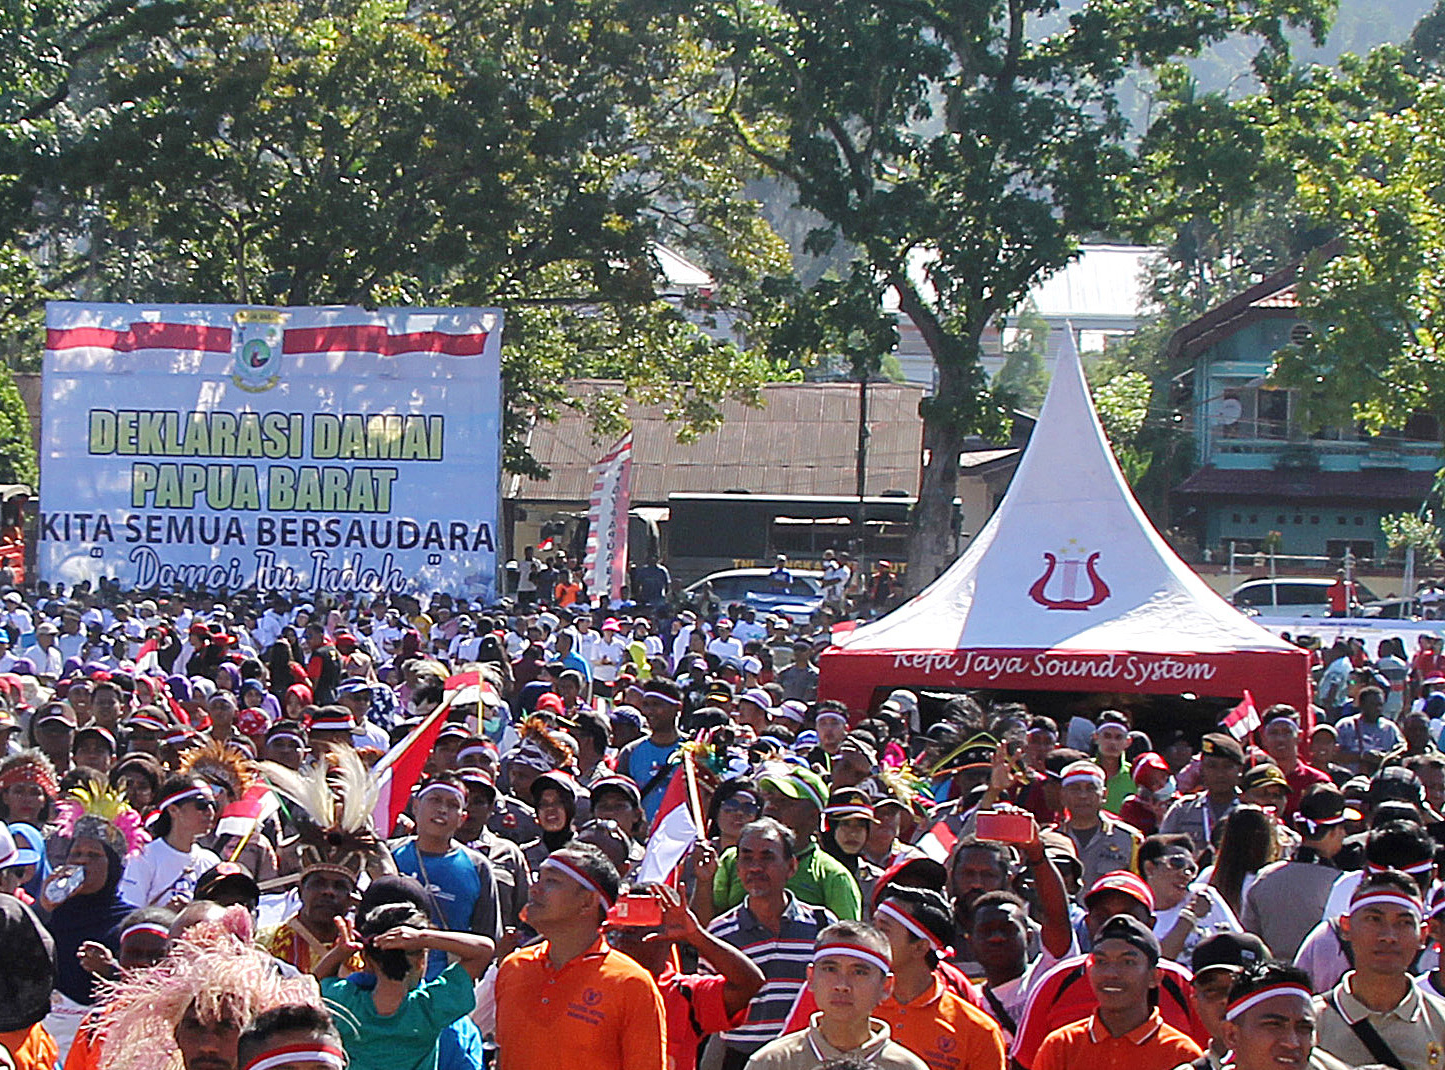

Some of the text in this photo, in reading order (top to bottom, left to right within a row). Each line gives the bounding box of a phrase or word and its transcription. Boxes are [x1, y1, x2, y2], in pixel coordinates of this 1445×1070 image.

[88, 409, 444, 461] DEKLARASI DAMAI
[131, 462, 398, 513] PAPUA BARAT
[39, 513, 496, 552] KITA SEMUA BERSAUDARA
[130, 546, 407, 593] Damai Itu Indah
[871, 563, 908, 574] LUT
[893, 652, 1217, 686] Kefa Jaya Sound System
